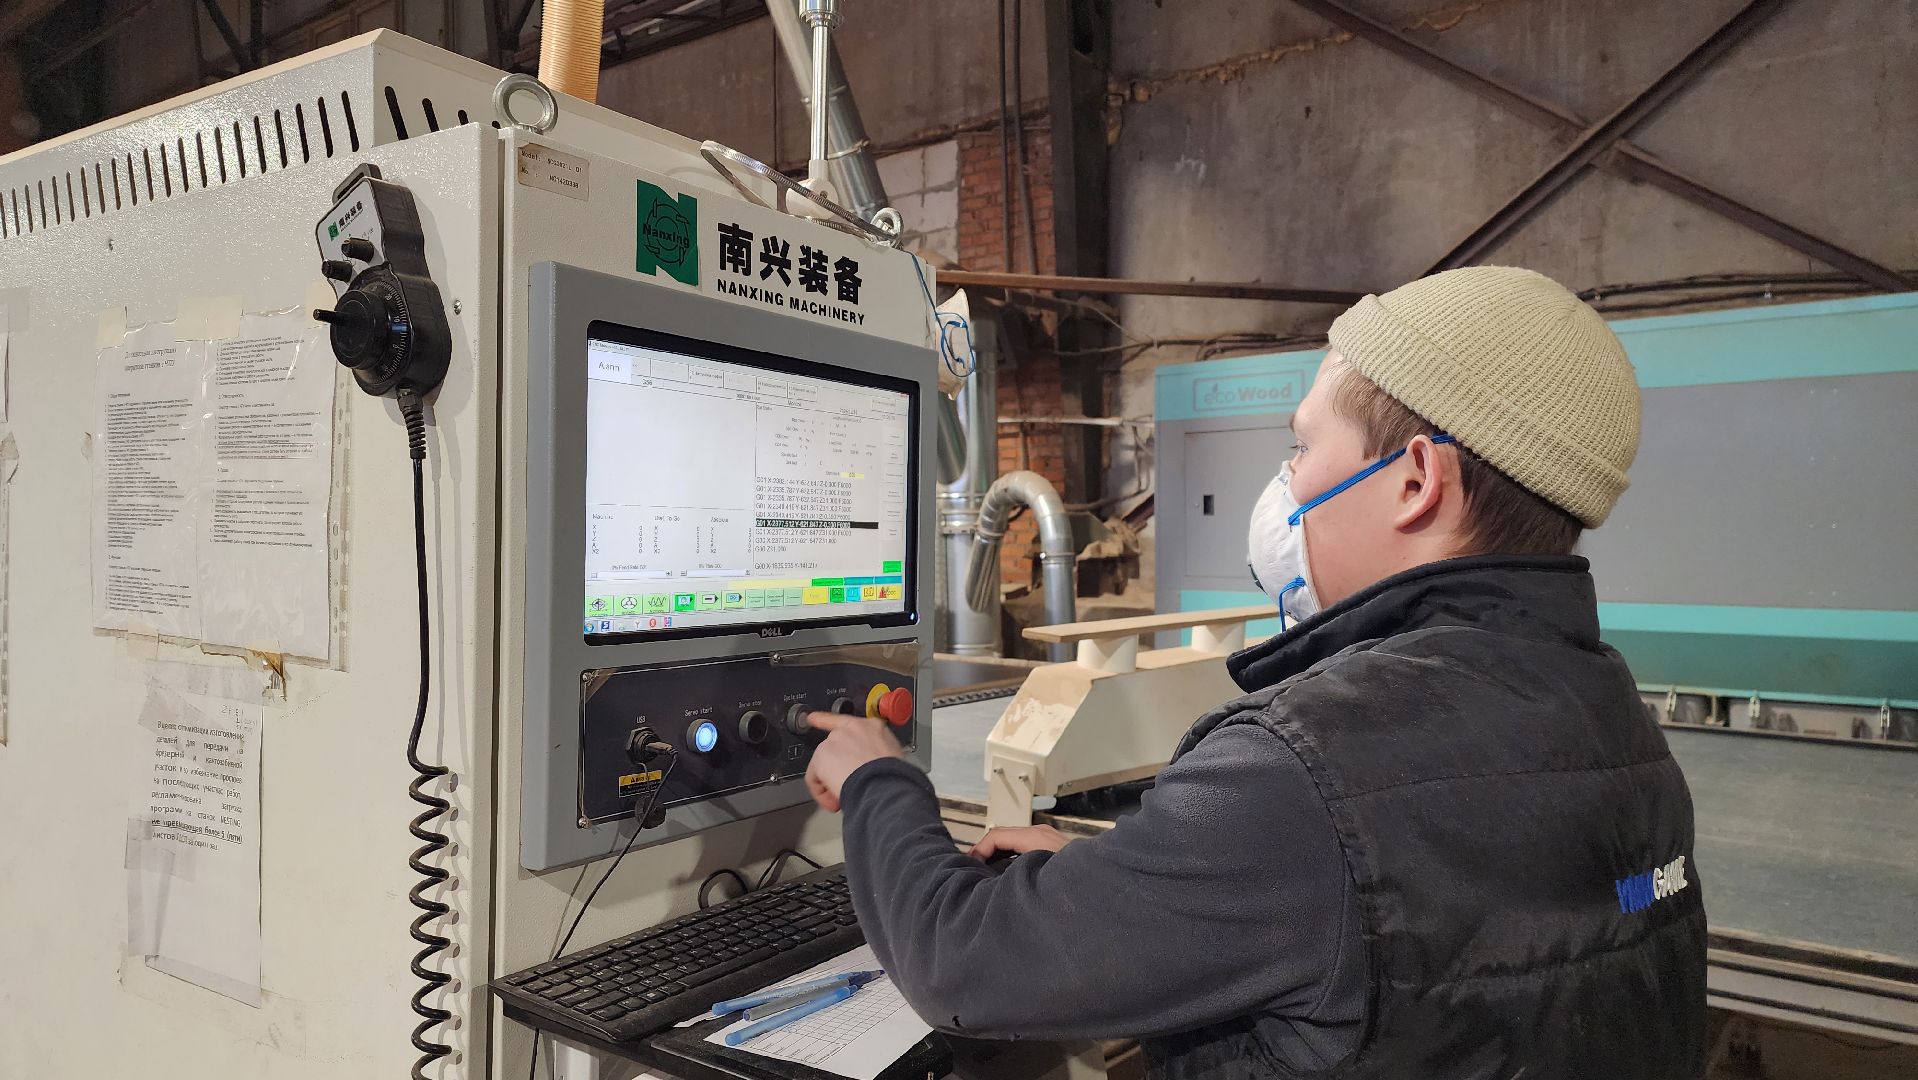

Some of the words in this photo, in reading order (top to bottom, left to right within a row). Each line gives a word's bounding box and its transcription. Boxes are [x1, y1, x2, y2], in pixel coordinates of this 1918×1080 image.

[642, 222, 690, 248] Nanxing
[718, 222, 863, 305] 南兴装备
[718, 278, 784, 306] NANXING
[790, 297, 866, 326] MACHINERY
[761, 627, 783, 638] DELL
[636, 716, 646, 724] USB
[684, 708, 699, 717] Servo
[700, 707, 713, 715] start
